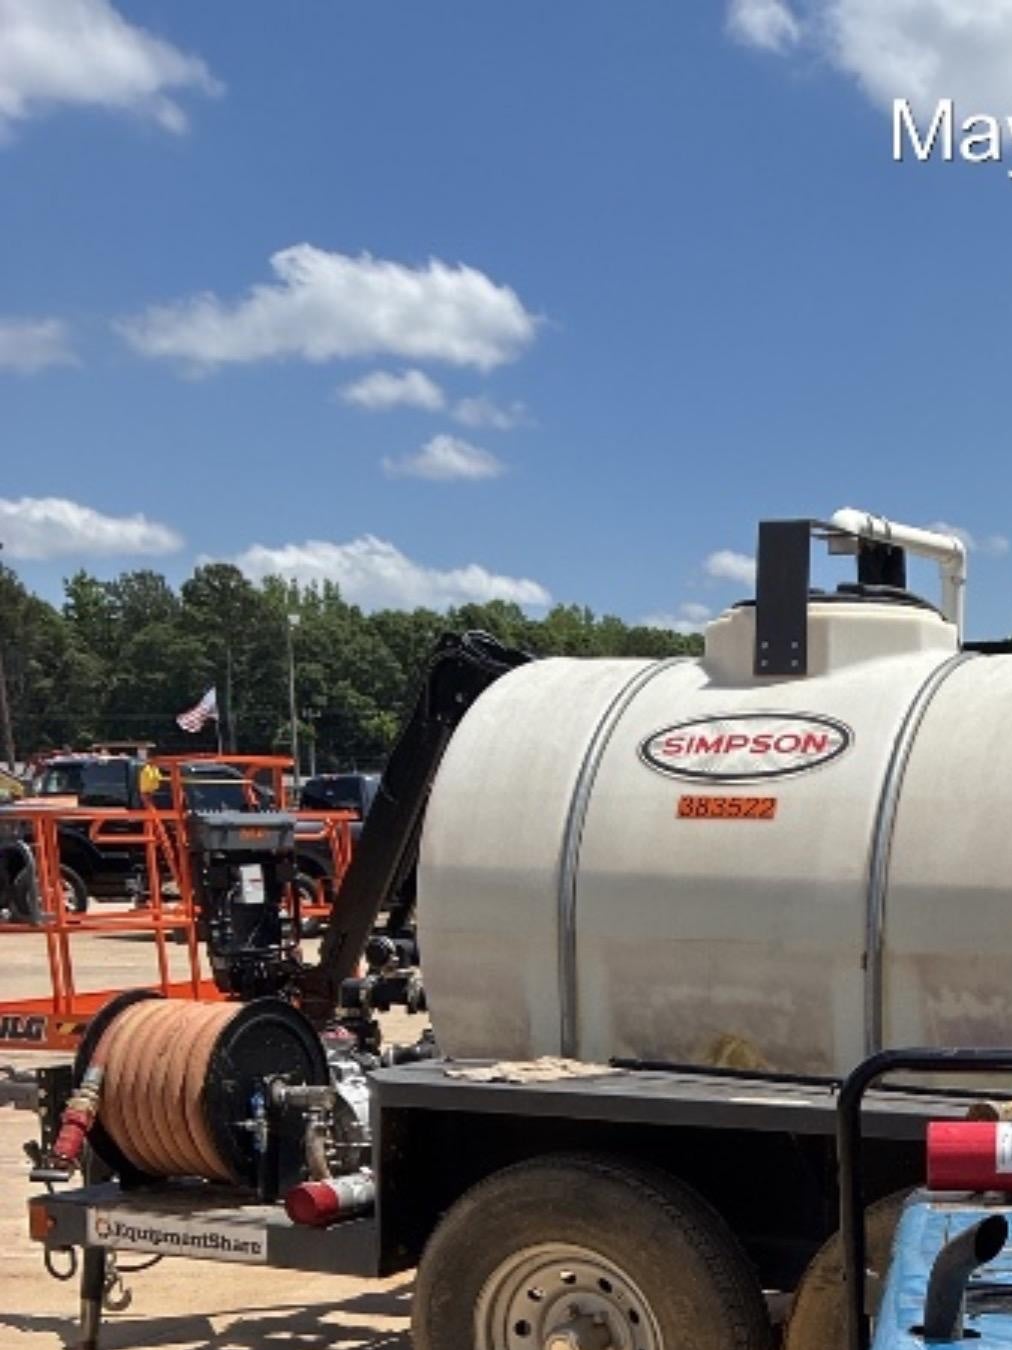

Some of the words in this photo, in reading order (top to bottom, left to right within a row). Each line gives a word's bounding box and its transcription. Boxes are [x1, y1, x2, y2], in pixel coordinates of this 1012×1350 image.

[662, 733, 829, 756] SIMPSON
[680, 797, 777, 817] 383522
[113, 1221, 263, 1255] EquipmentShare
